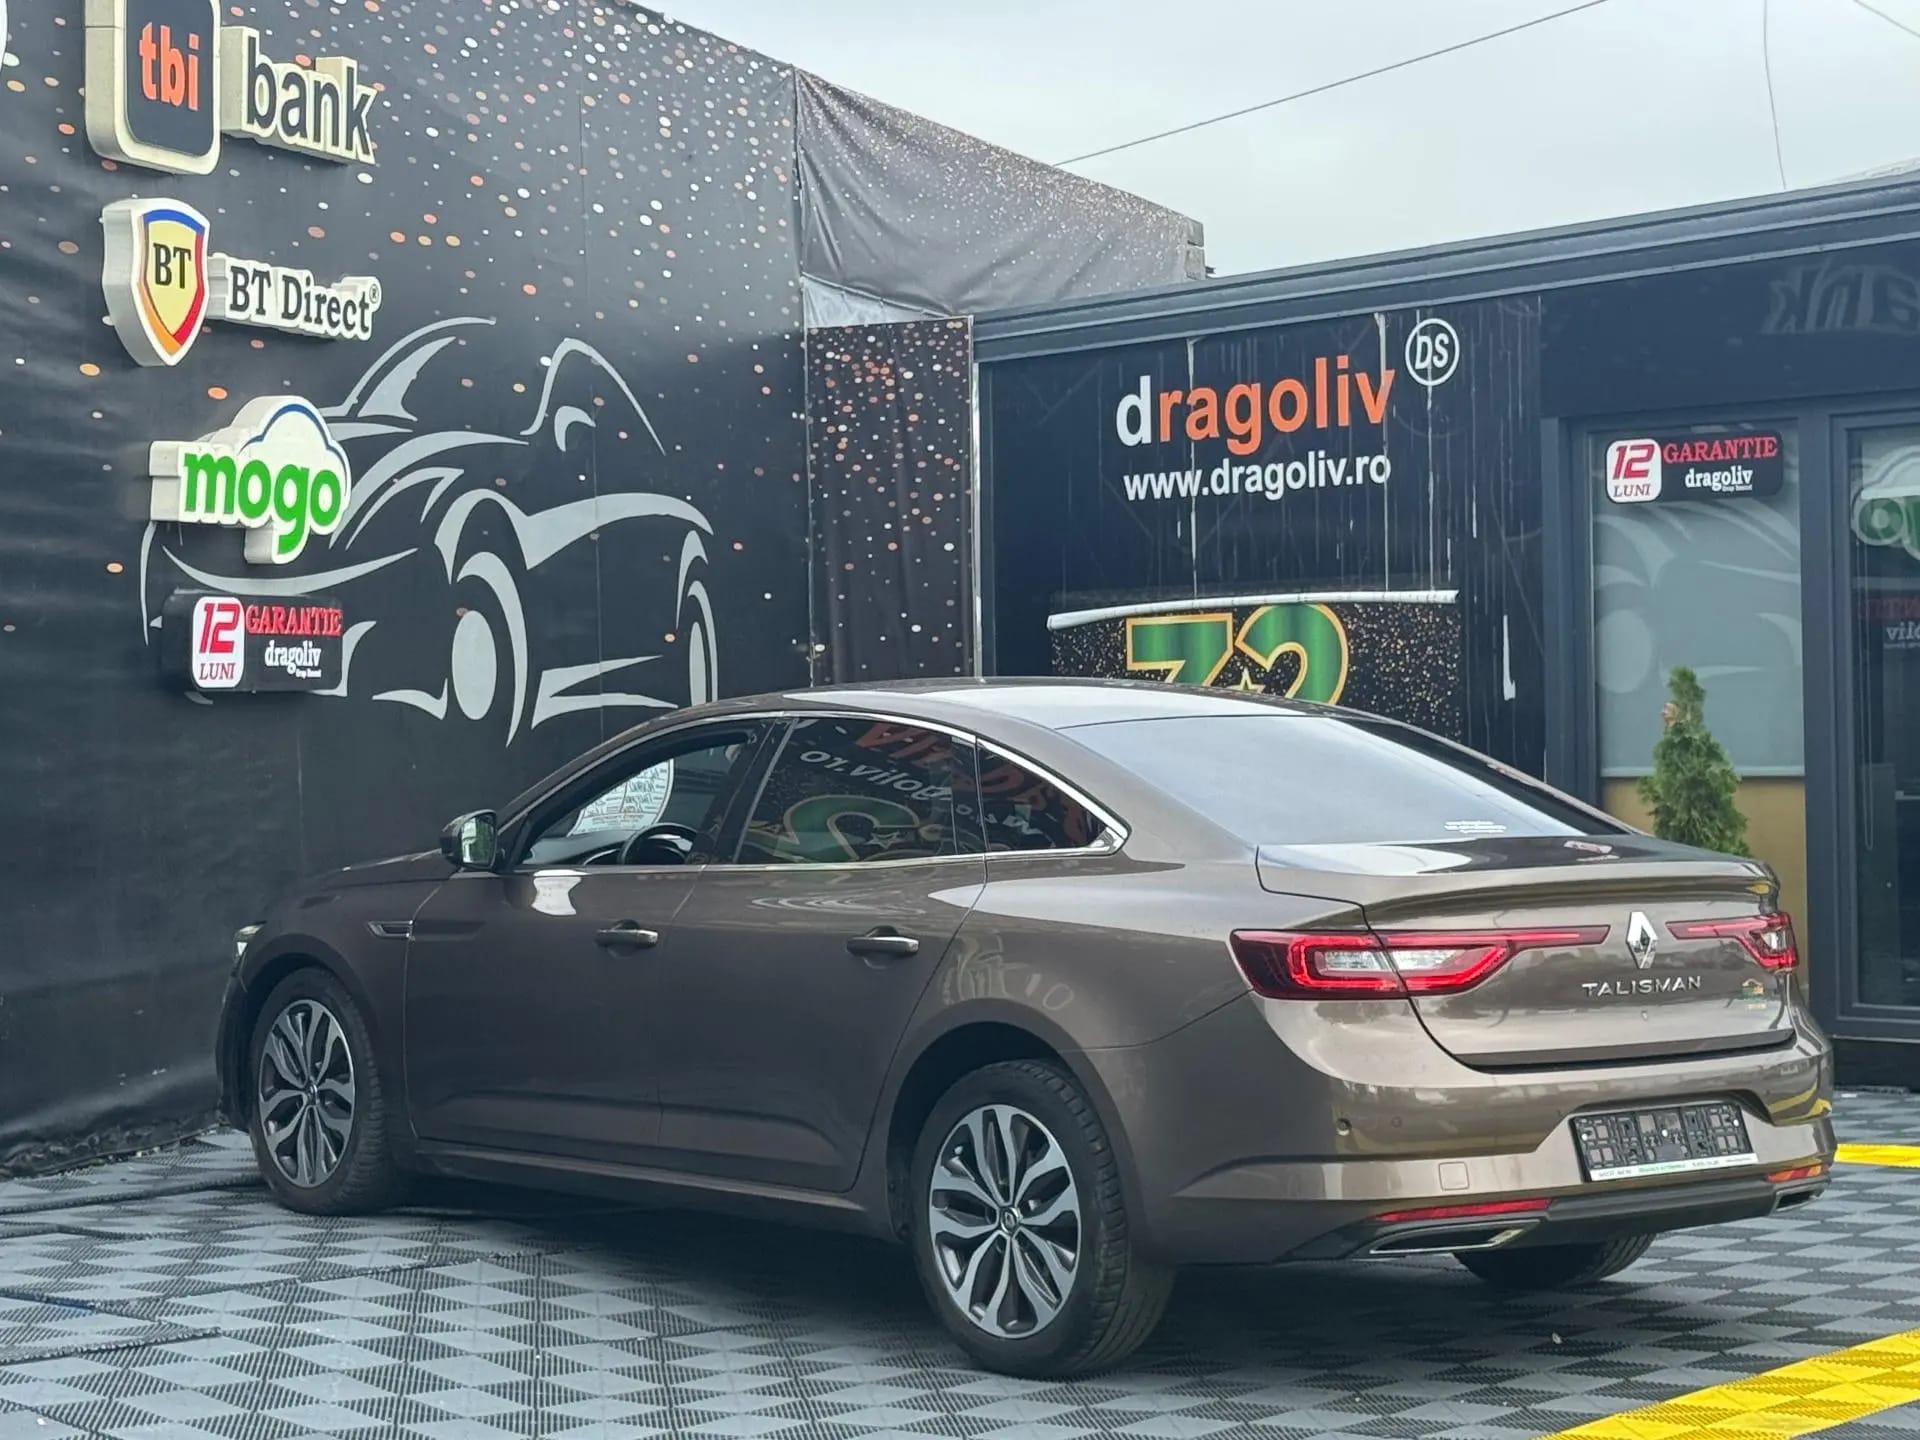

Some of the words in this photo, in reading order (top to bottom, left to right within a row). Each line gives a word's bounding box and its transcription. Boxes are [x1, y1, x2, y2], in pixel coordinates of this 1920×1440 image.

[138, 22, 199, 111] tbi
[247, 36, 377, 156] bank
[153, 242, 192, 289] BT
[229, 266, 272, 316] BT
[1414, 331, 1449, 371] DS
[1115, 354, 1396, 456] dragoliv
[1612, 443, 1655, 480] 12
[1663, 436, 1778, 464] GARANTIE
[1123, 450, 1392, 501] www.dragoliv.ro
[1613, 483, 1651, 498] LUNI
[1685, 465, 1753, 491] dragoliv
[183, 452, 342, 555] mogo
[199, 603, 241, 654] 12
[245, 604, 342, 637] GARANTIE
[199, 662, 235, 681] LUNI
[264, 639, 322, 674] dragoliv
[1581, 975, 1701, 998] TALISMAN
